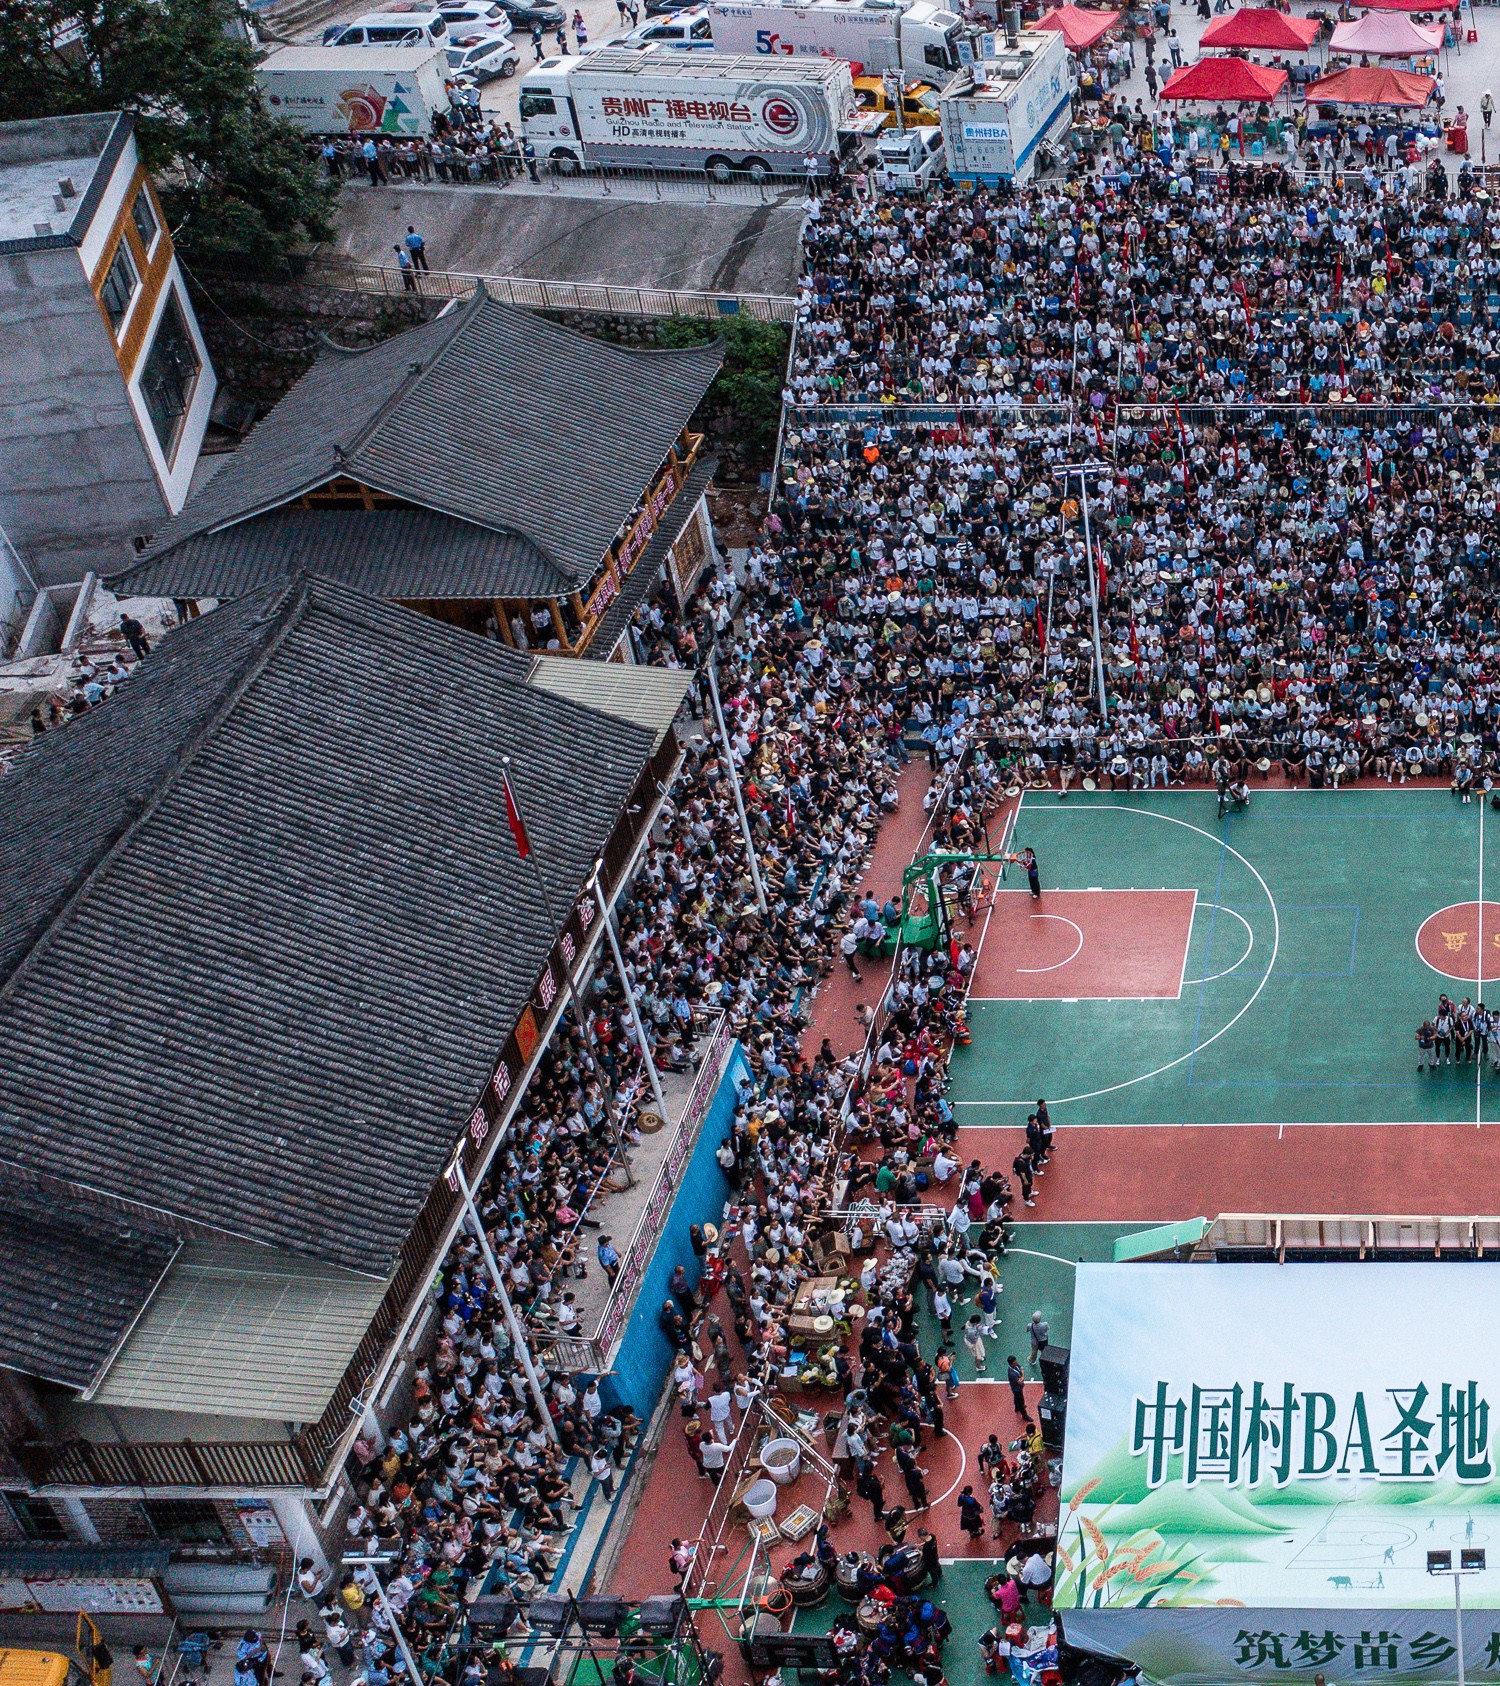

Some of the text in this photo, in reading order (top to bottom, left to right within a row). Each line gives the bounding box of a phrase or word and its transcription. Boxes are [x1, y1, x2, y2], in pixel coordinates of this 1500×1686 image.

[756, 29, 794, 56] 5G
[602, 97, 751, 123] 贵州广播电视台
[612, 126, 631, 136] HD
[726, 123, 755, 131] Station
[965, 127, 1009, 138] 贵州村BA
[1133, 1380, 1491, 1484] 中国村BA圣地
[1233, 1629, 1457, 1671] 筑梦苗乡
